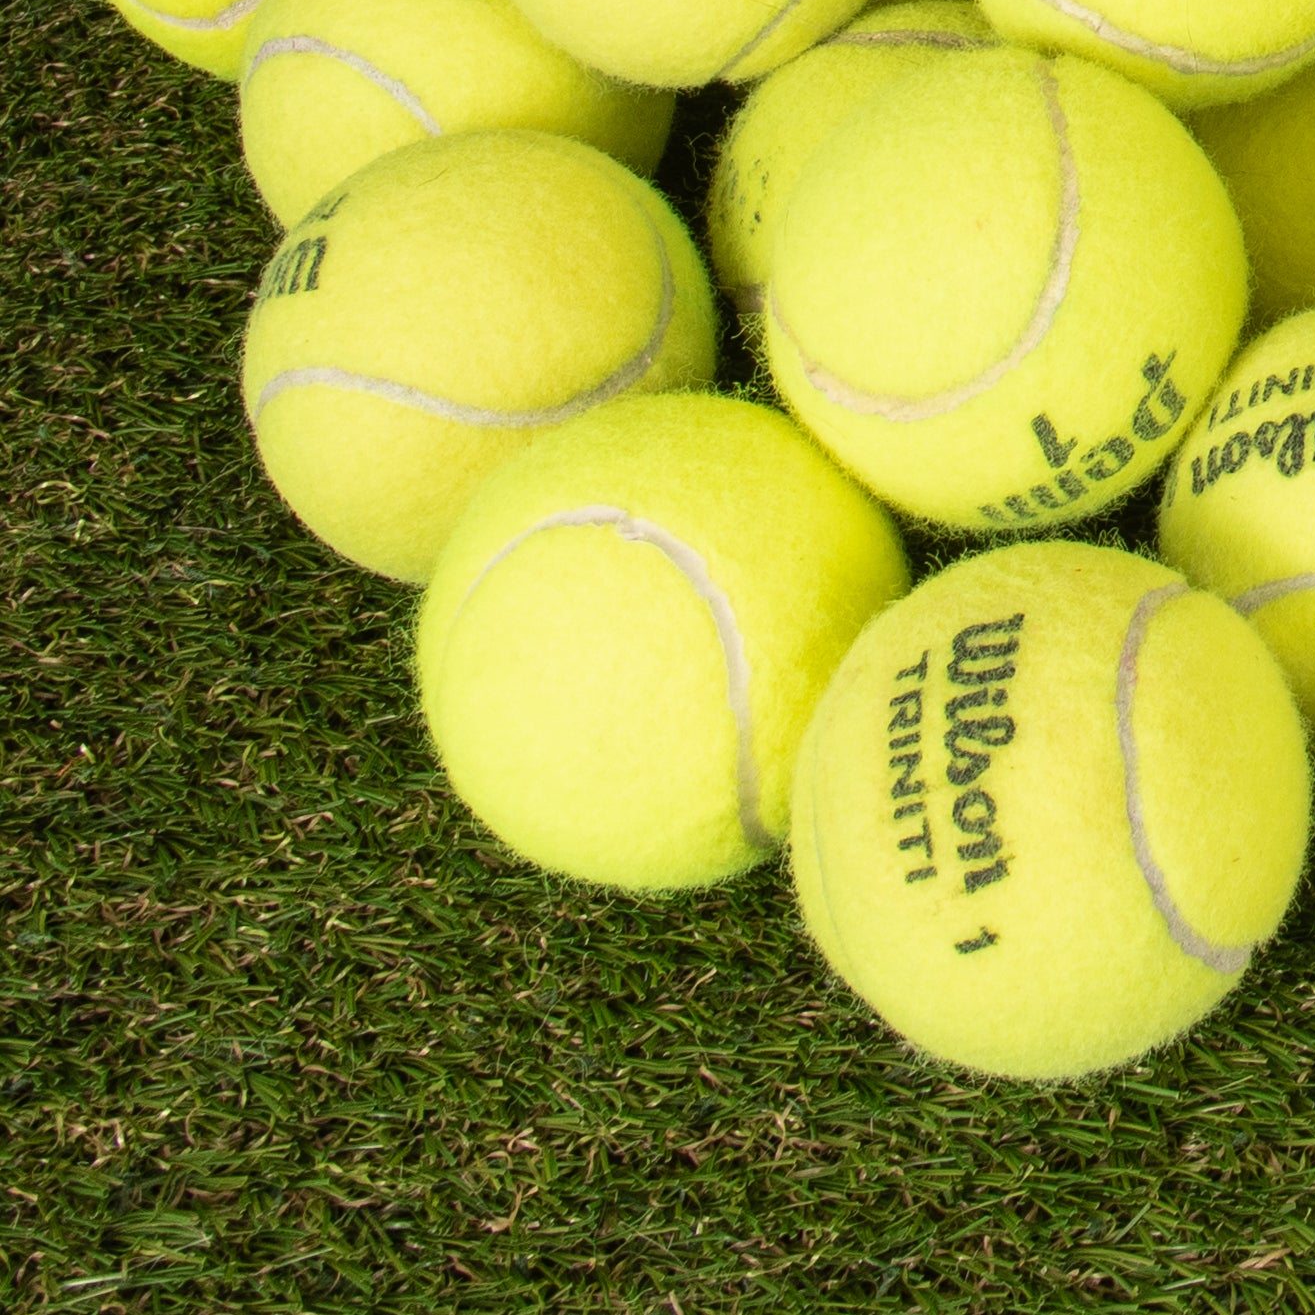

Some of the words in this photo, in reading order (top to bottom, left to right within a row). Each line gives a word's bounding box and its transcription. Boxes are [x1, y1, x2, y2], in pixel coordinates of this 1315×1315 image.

[1031, 413, 1079, 470] 1
[887, 649, 938, 884] TRINITI
[944, 613, 1026, 894] Wilson
[954, 927, 1000, 955] 1
